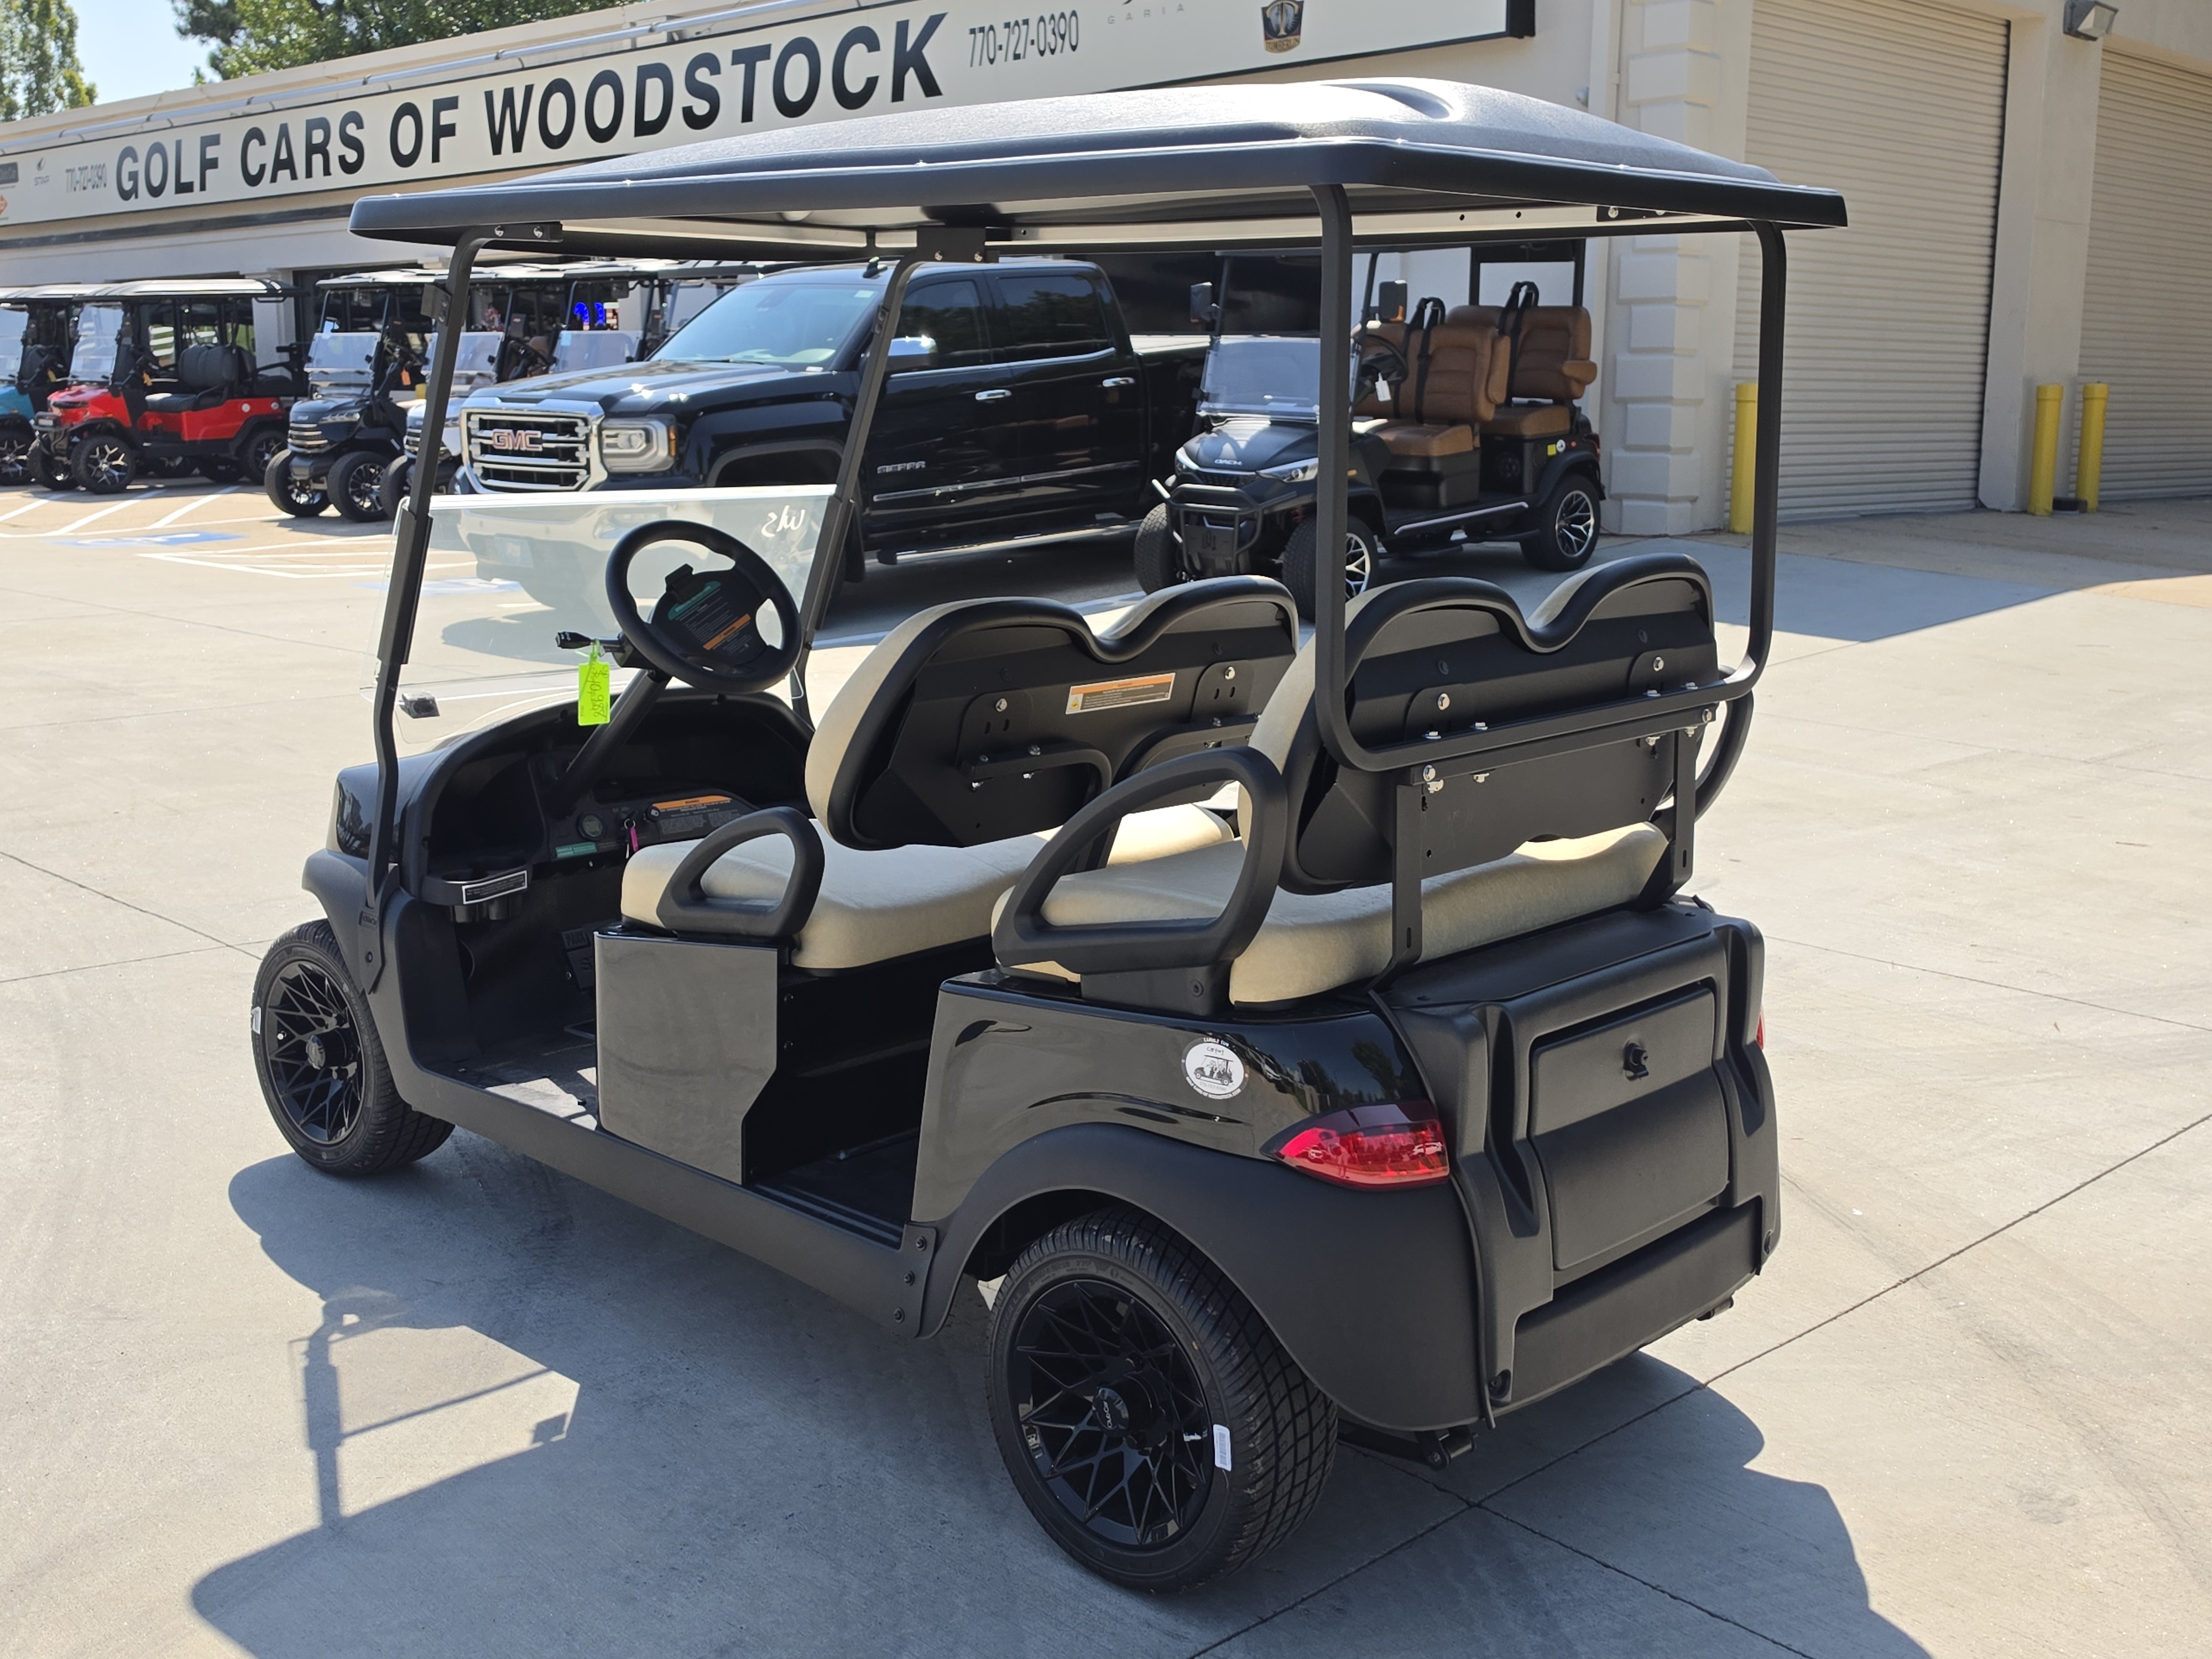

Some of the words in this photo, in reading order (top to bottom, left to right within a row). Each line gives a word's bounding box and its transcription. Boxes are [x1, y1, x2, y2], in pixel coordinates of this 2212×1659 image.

[1107, 3, 1185, 24] GARIA
[968, 10, 1079, 67] 770-727-0390
[116, 133, 221, 202] GOLF
[239, 110, 366, 187] CARS
[389, 95, 460, 168] OF
[484, 12, 949, 156] WOODSTOCK
[492, 428, 542, 452] GMC
[877, 461, 926, 474] SIERRA
